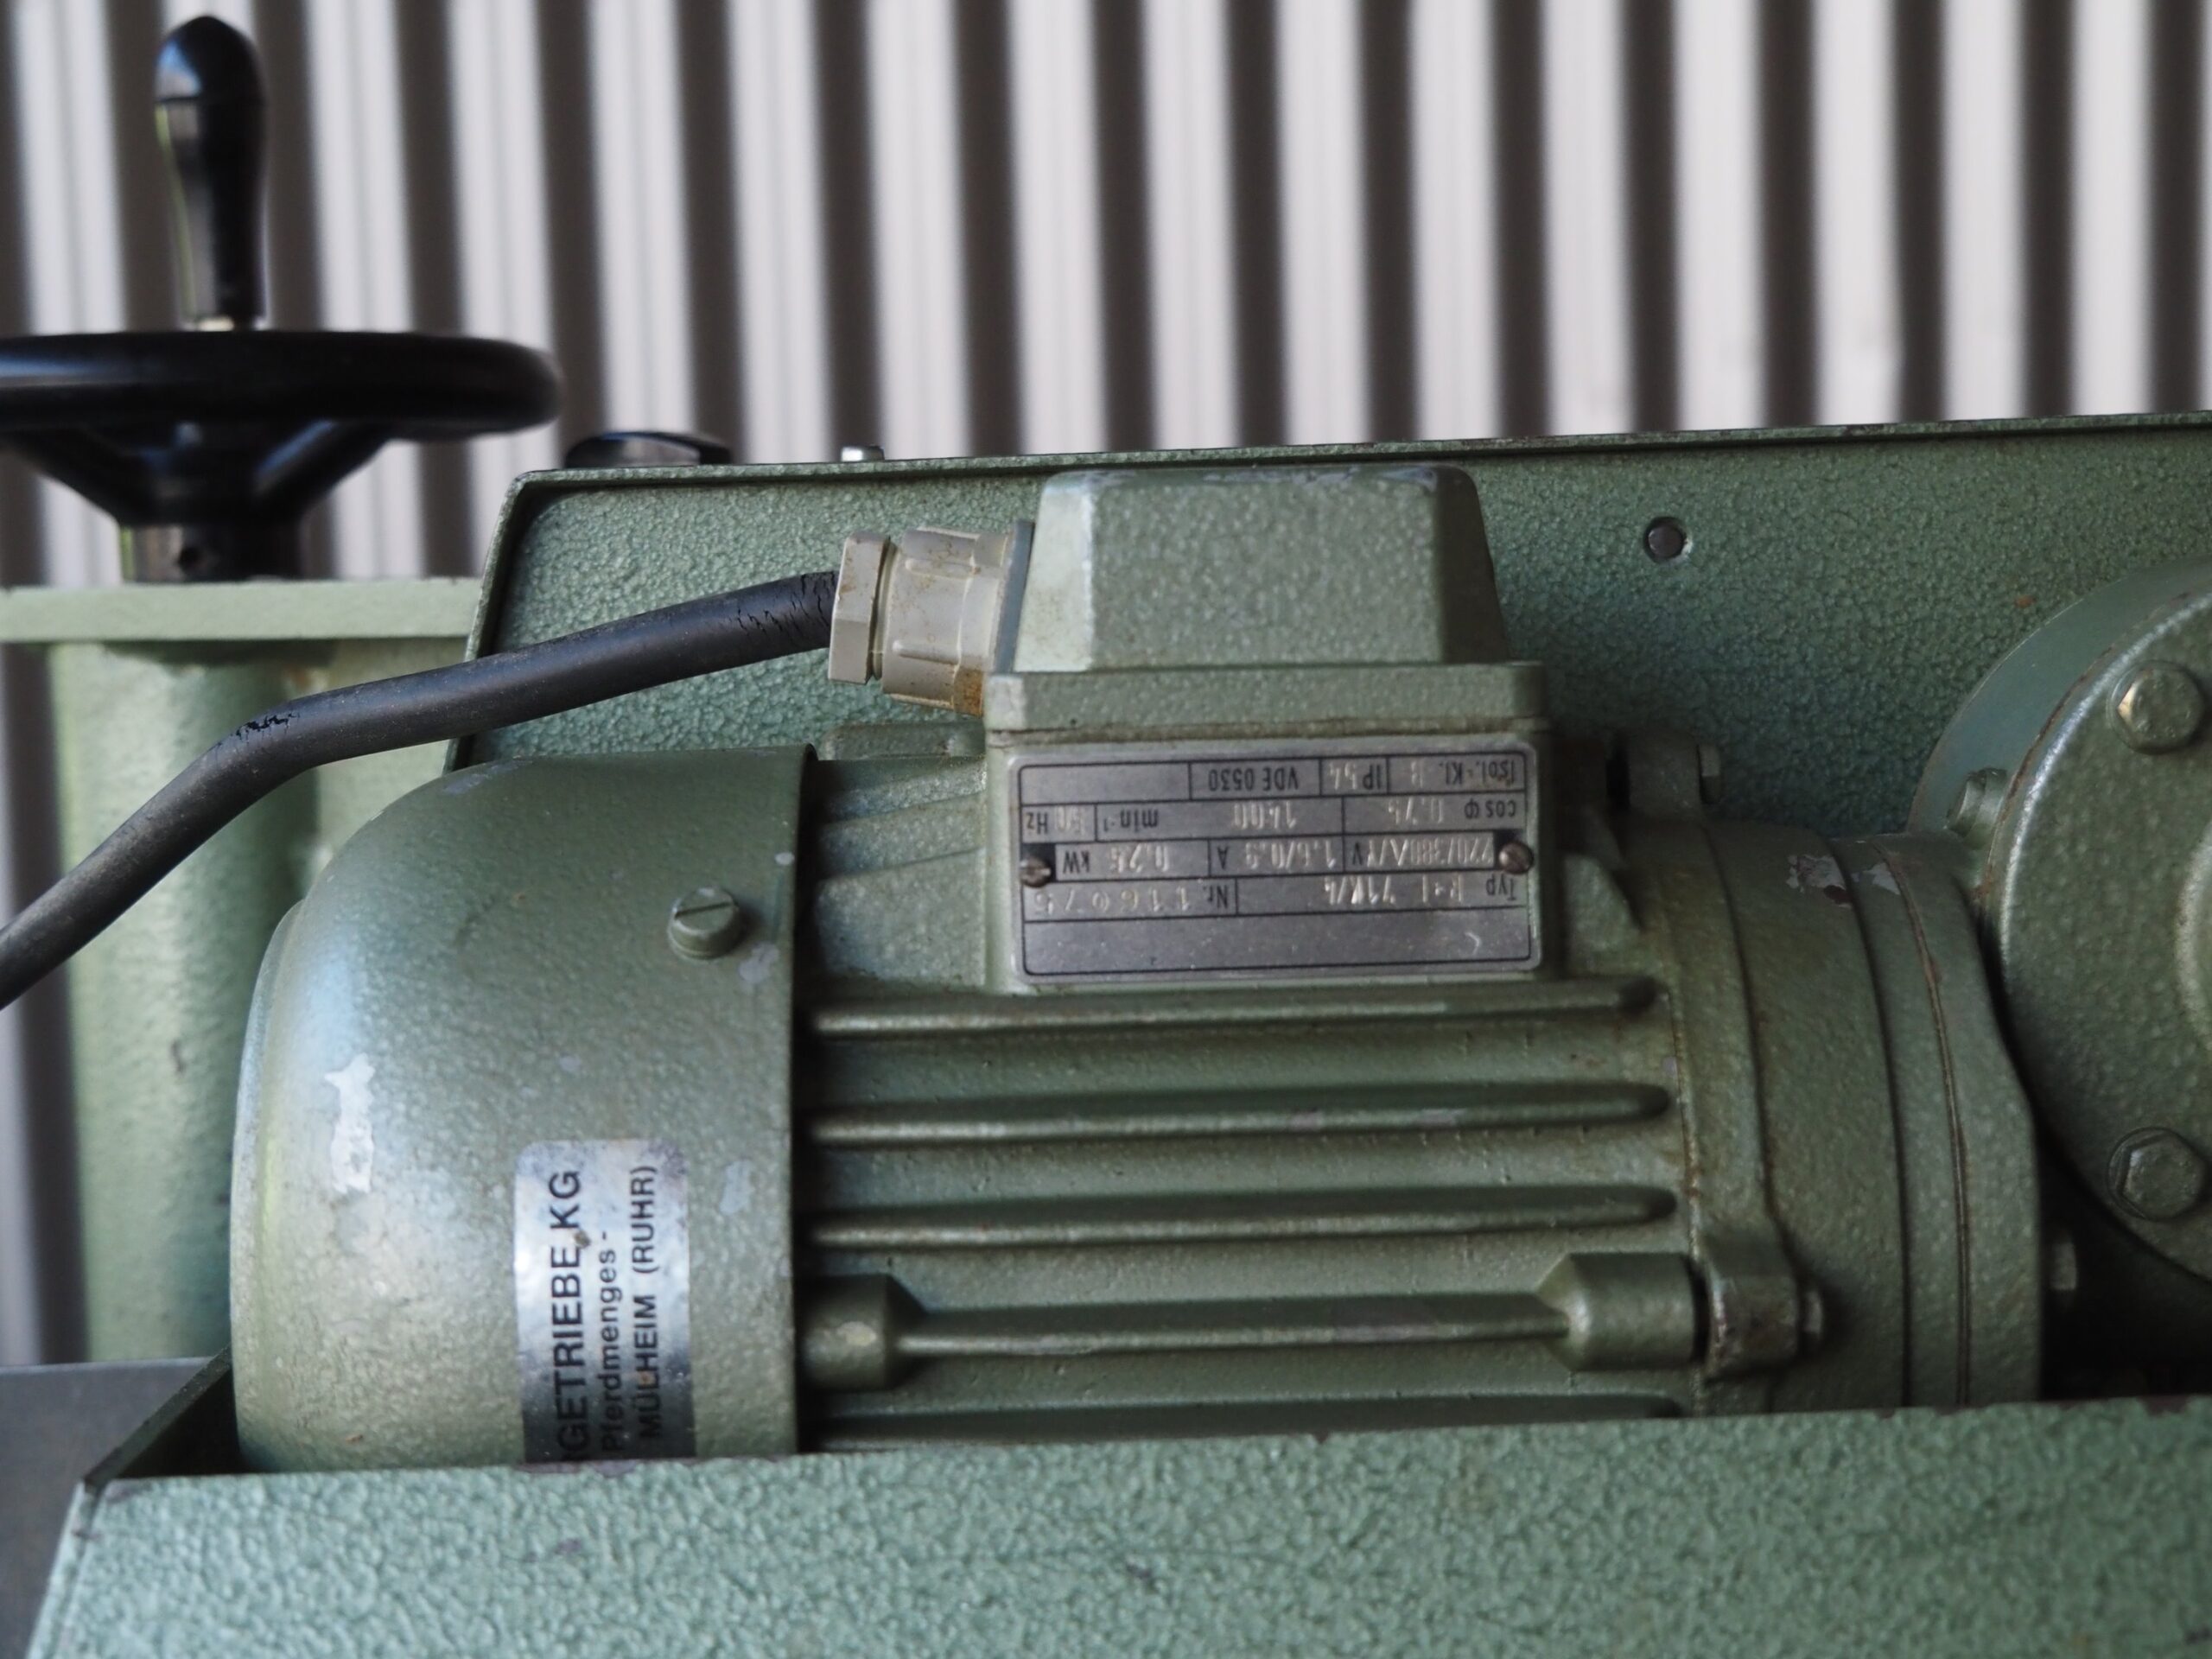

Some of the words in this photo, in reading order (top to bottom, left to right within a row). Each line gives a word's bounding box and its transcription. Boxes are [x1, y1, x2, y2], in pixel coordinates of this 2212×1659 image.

[1209, 767, 1254, 793] 0530
[1262, 766, 1298, 791] VDE
[1362, 764, 1382, 790] IP
[1484, 799, 1517, 820] cos
[1027, 811, 1048, 835] Hz
[1063, 850, 1090, 874] kW
[1217, 845, 1230, 870] A
[1352, 841, 1363, 866] V
[1202, 885, 1229, 910] Nr.
[1485, 873, 1517, 901] Typ
[549, 1170, 582, 1229] KG
[630, 1166, 660, 1274] (RUHR)
[632, 1294, 663, 1439] MÜLHEIM
